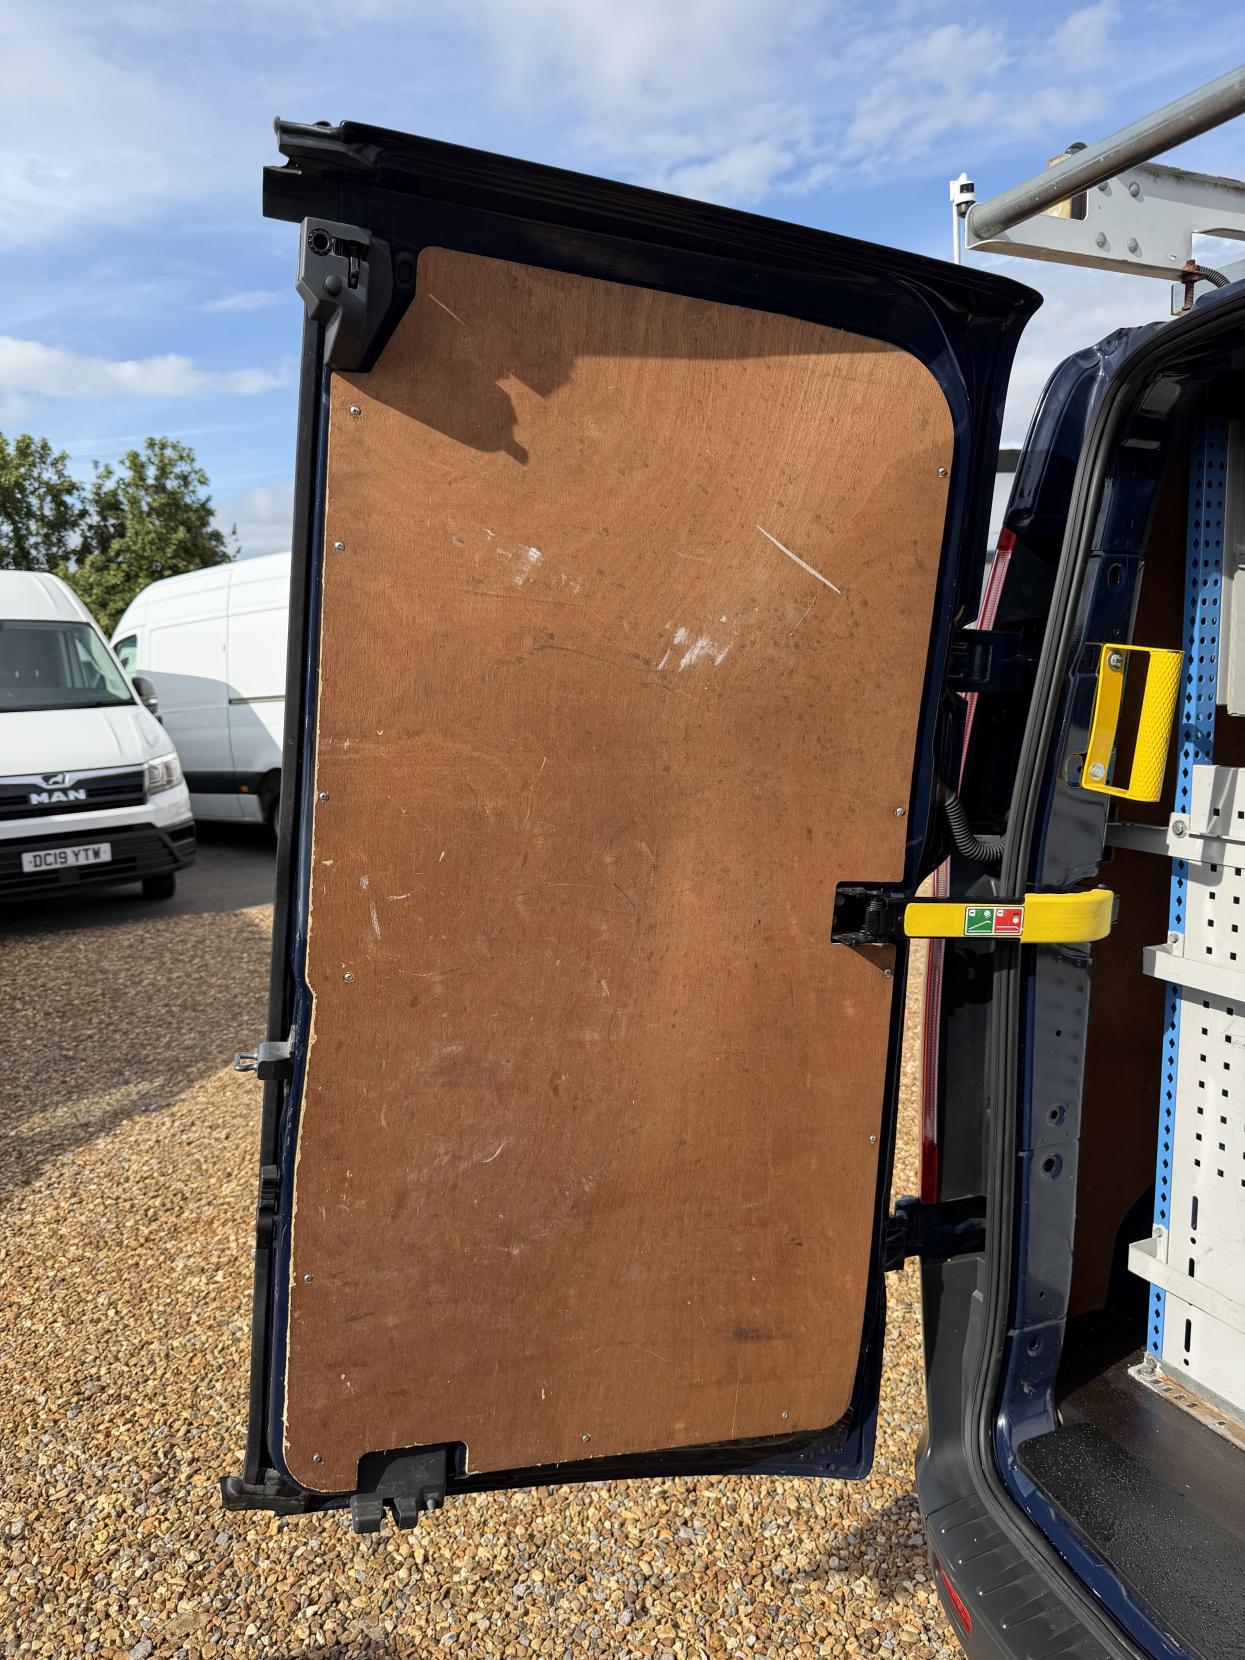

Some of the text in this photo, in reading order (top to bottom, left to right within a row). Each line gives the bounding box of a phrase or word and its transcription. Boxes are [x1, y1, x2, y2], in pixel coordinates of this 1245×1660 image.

[30, 788, 87, 804] MAN
[33, 847, 101, 868] DC19 YTW
